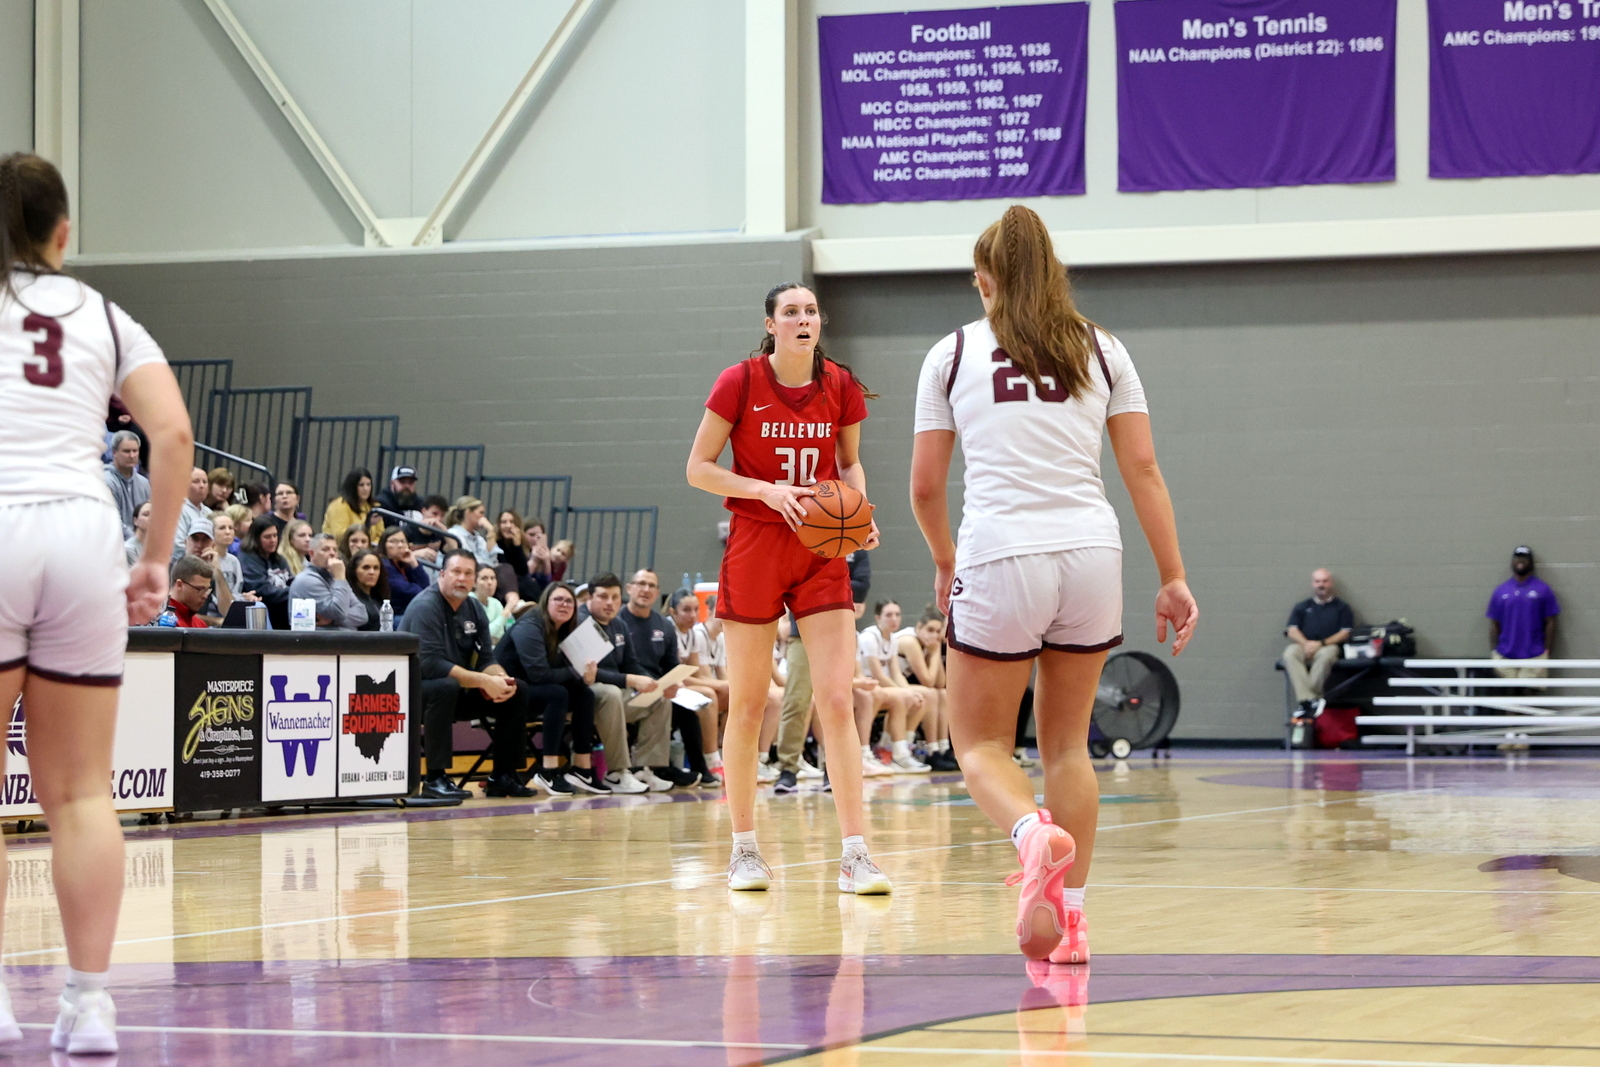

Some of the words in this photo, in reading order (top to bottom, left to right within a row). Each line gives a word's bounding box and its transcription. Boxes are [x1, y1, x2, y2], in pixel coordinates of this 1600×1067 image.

[1504, 0, 1572, 22] Men's
[911, 21, 991, 43] Football
[1182, 17, 1247, 40] Men's
[1253, 12, 1327, 36] Tennis
[1442, 30, 1480, 46] AMC
[1483, 28, 1576, 46] Champions:
[853, 50, 895, 65] NWOC
[898, 48, 976, 64] Champions:
[1129, 48, 1166, 63] NAIA
[1168, 45, 1251, 62] Champions
[1254, 41, 1314, 61] (District
[1316, 39, 1344, 57] 22):
[841, 68, 872, 82] MOL
[874, 66, 951, 82] Champions:
[954, 64, 988, 77] 1951,
[1028, 60, 1062, 74] 1957,
[860, 102, 892, 115] MOC
[894, 100, 972, 115] Champions:
[874, 117, 912, 132] HBCC
[914, 116, 992, 131] Champions:
[998, 112, 1030, 126] 1972
[841, 136, 874, 149] NAIA
[876, 133, 929, 148] National
[931, 130, 988, 146] Playoffs:
[878, 151, 910, 165] AMC
[912, 148, 990, 165] Champions:
[873, 168, 912, 182] HCAC
[914, 166, 991, 181] Champions:
[23, 314, 64, 388] 3
[760, 422, 832, 438] BELLEVUE
[774, 447, 820, 486] 30
[952, 577, 963, 596] G
[207, 680, 254, 693] MASTERPIECE
[348, 693, 400, 713] FARMERS
[182, 690, 254, 764] SIGNS
[269, 712, 331, 730] Wannemacher
[342, 713, 405, 735] EQUIPMENT
[341, 772, 360, 783] URBANA
[365, 771, 388, 782] LAKEVIEW
